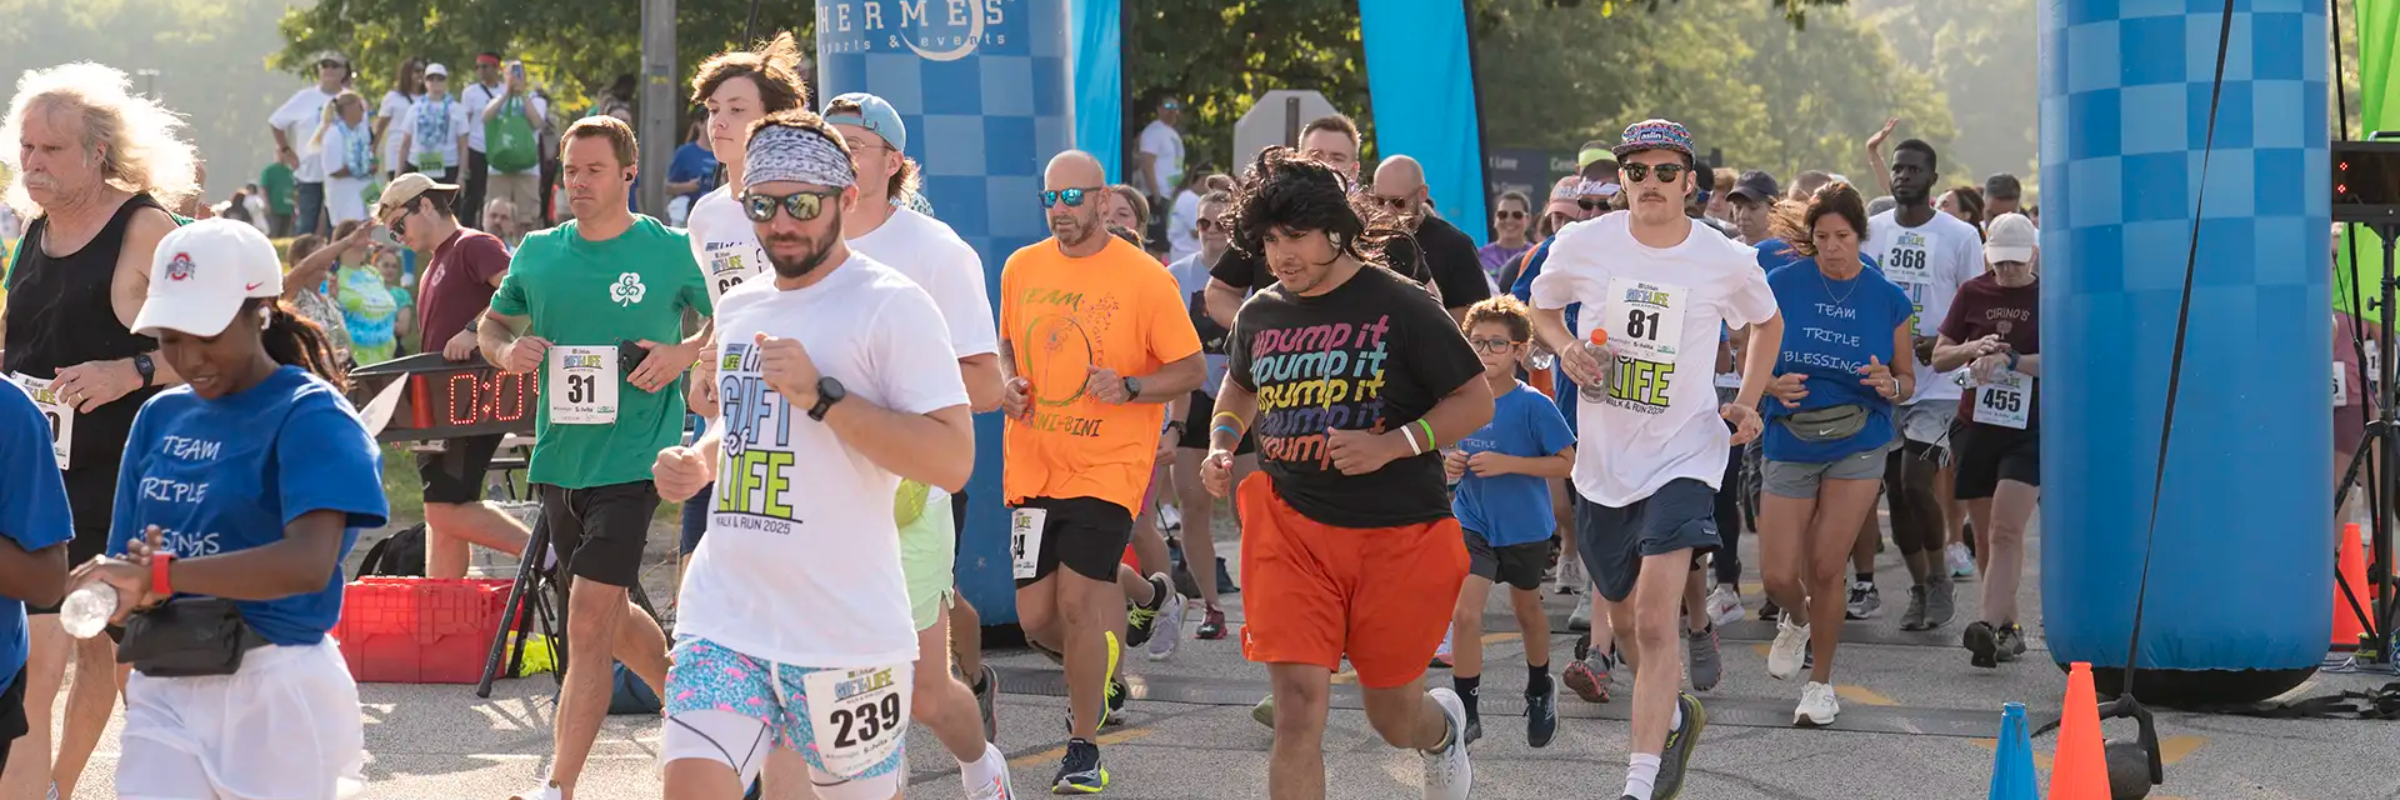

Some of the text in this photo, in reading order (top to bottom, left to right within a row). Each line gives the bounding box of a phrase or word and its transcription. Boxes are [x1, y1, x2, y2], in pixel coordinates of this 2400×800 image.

[820, 0, 1004, 34] HERMES
[820, 33, 1005, 54] sports & events
[1890, 247, 1926, 270] 368
[1815, 303, 1856, 319] TEAM
[1985, 307, 2030, 321] CIRINO'S
[1355, 314, 1389, 349] it
[1627, 309, 1660, 341] 81
[1802, 327, 1860, 348] TRIPLE
[1353, 341, 1388, 378] it
[1784, 351, 1869, 376] BLESSING
[567, 374, 595, 404] 31
[1354, 369, 1385, 402] it
[1624, 401, 1631, 410] &
[1632, 403, 1648, 414] RUN
[1983, 388, 2021, 413] 455
[163, 435, 221, 460] TEAM
[717, 449, 795, 520] LIFE
[740, 517, 761, 530] RUN
[763, 519, 791, 535] 2025
[830, 692, 900, 749] 239
